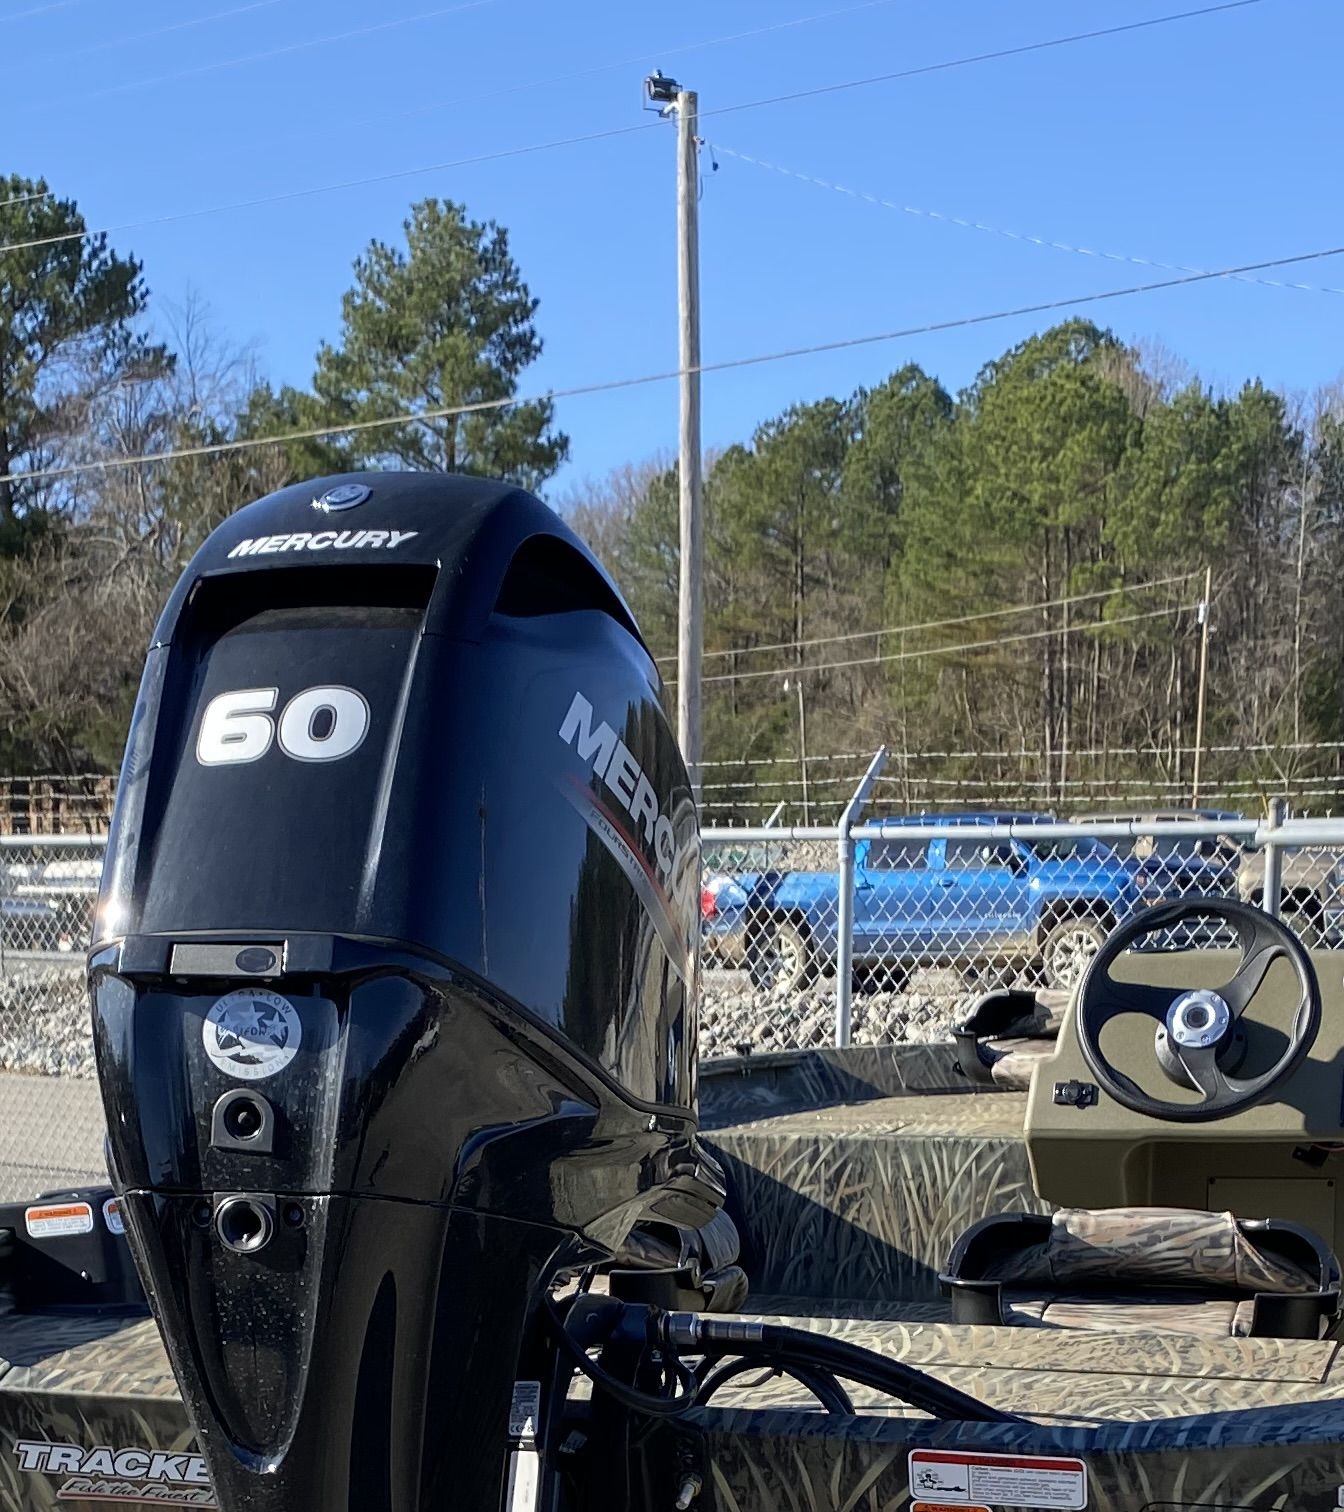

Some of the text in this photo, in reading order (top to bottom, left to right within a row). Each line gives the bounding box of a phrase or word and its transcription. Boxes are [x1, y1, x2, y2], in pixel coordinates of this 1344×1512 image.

[226, 530, 419, 559] MERCURY
[195, 683, 372, 766] 60
[266, 992, 292, 1014] LOW
[65, 1480, 106, 1494] Fish
[110, 1482, 140, 1496] the
